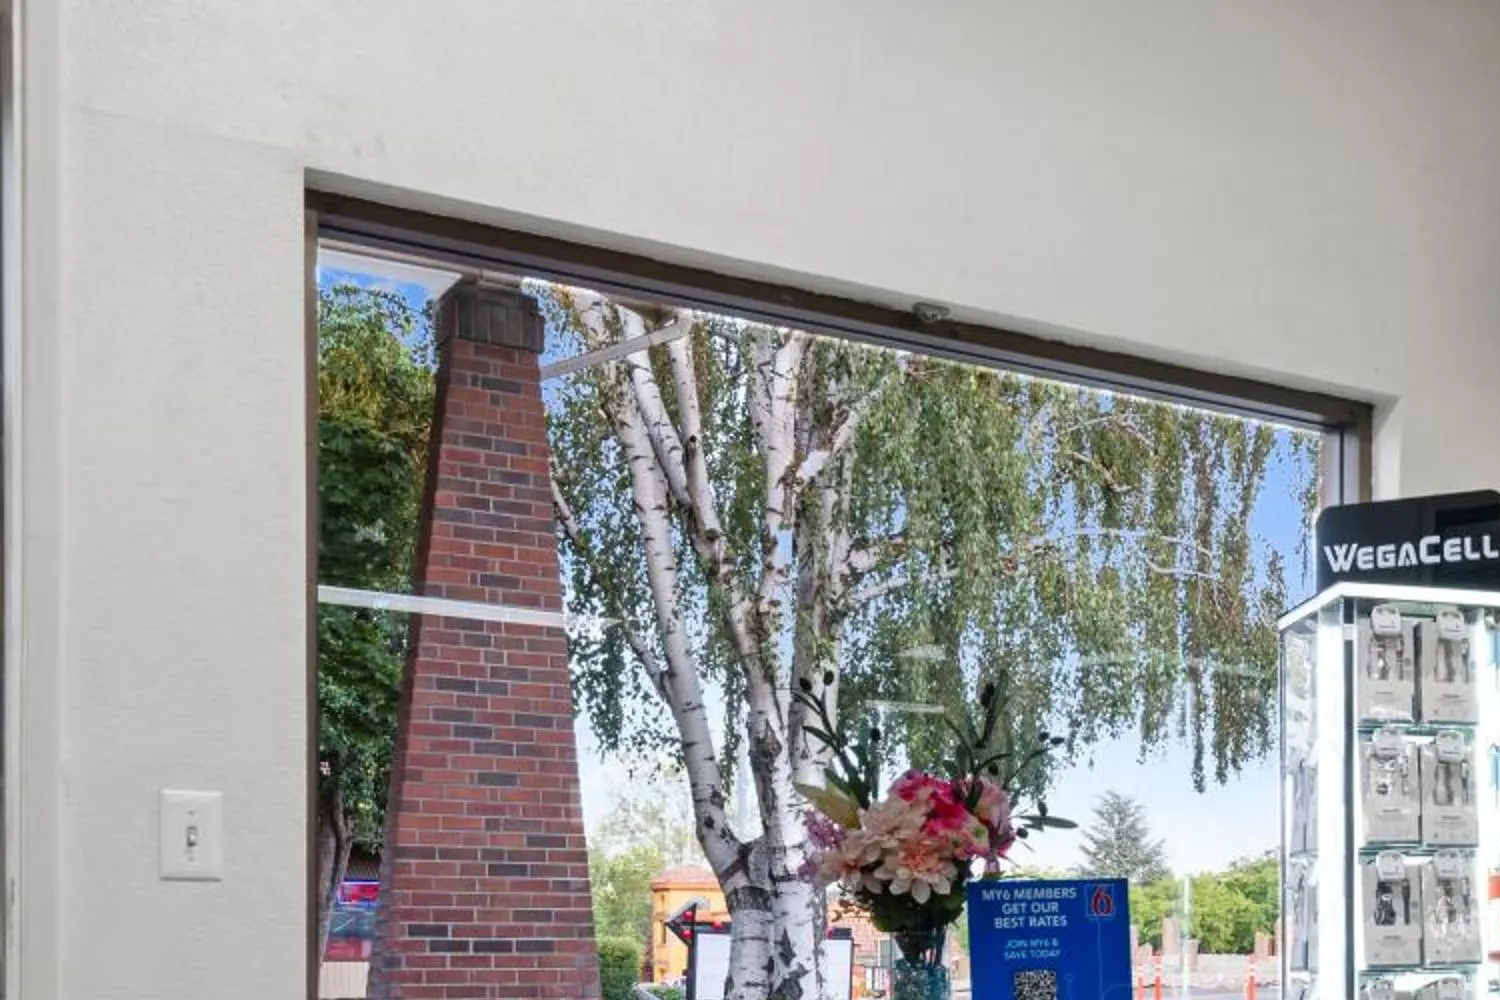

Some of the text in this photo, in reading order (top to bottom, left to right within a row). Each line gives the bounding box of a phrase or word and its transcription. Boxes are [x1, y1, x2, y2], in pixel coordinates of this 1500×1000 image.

[981, 887, 1077, 901] MY6 MEMBERS
[1001, 901, 1059, 915] GET OUR
[994, 915, 1068, 929] BEST RATES
